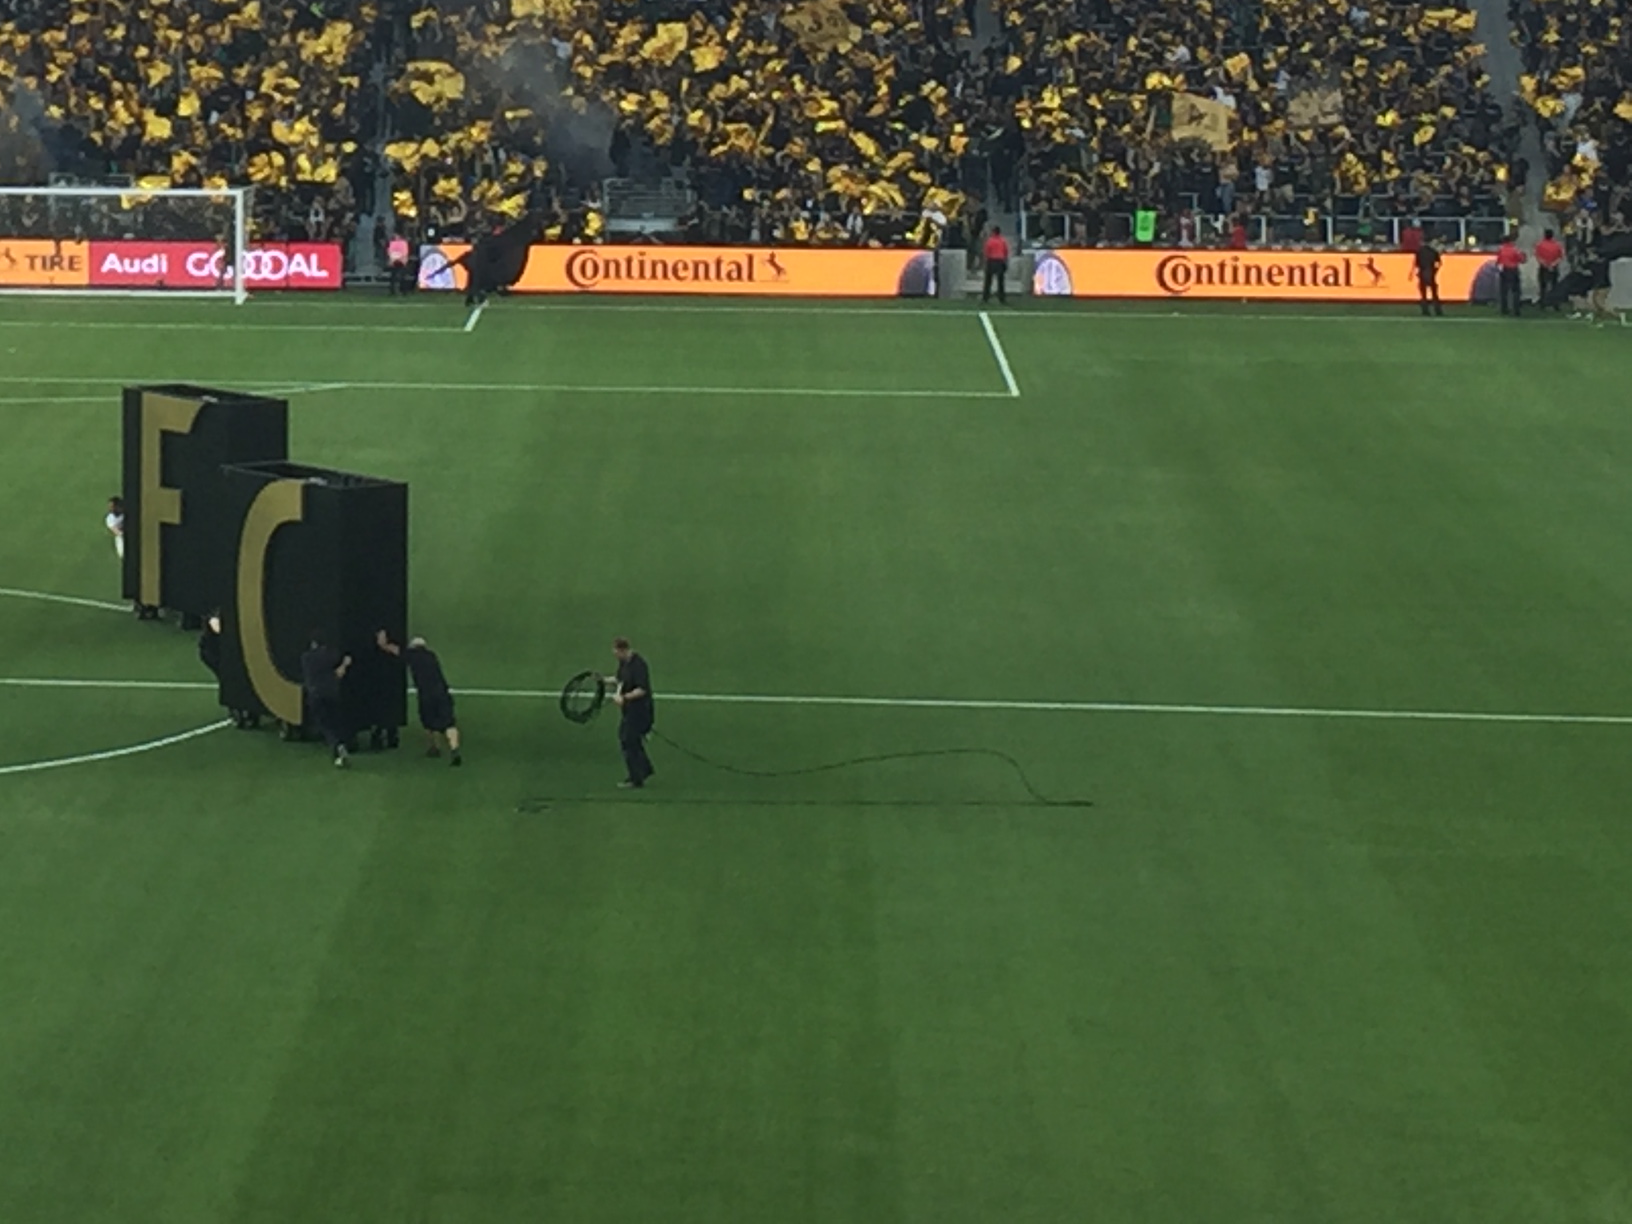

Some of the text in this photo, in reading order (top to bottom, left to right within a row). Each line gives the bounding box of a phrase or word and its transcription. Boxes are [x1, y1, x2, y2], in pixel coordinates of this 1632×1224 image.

[25, 254, 82, 272] TIRE
[101, 251, 168, 275] Audi
[565, 248, 755, 289] Continental
[1155, 253, 1353, 293] Continental
[140, 391, 206, 606] F
[236, 479, 304, 725] C
